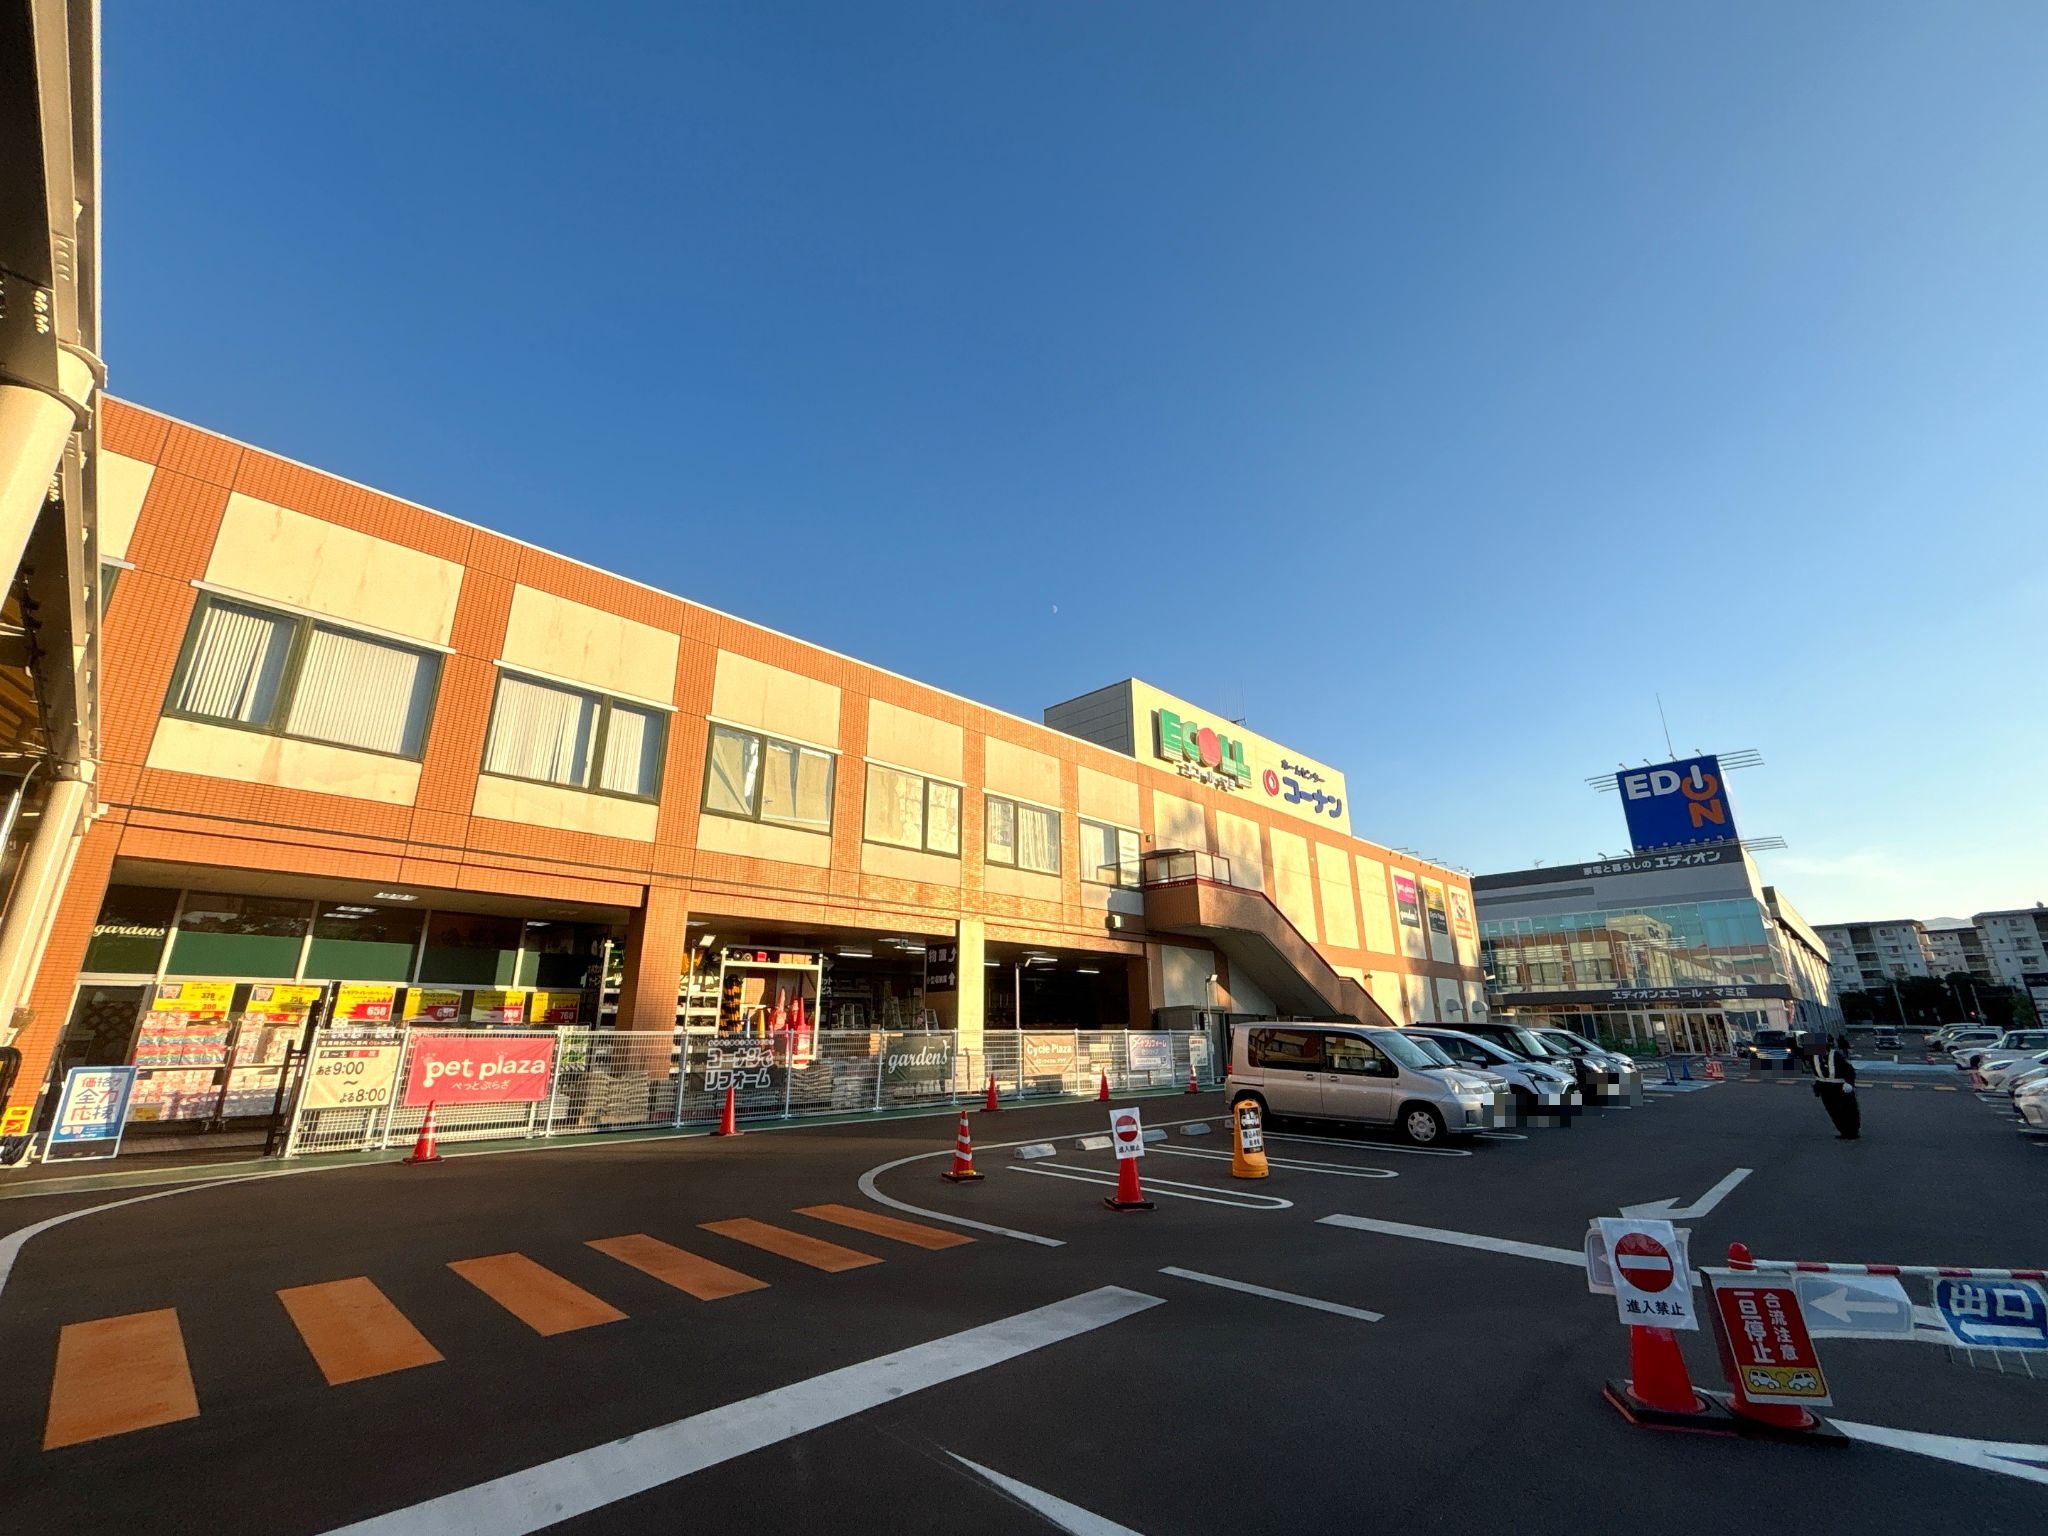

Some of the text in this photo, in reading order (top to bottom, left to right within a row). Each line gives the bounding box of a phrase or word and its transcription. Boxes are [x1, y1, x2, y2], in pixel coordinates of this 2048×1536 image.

[1159, 708, 1251, 788] ECOLL
[1281, 759, 1325, 783] ホームセンター
[1283, 776, 1342, 818] コーナン
[1583, 851, 1721, 876] 家電と暮らしの エディオン
[92, 924, 166, 938] gardens
[1612, 987, 1748, 1000] エディオンエコール・マミ店
[366, 1006, 387, 1016] 658
[706, 1047, 774, 1069] コーナンで
[888, 1039, 949, 1074] gardens
[1026, 1043, 1073, 1057] Cycle Plaza
[316, 1061, 365, 1075] あさ9:00
[423, 1053, 546, 1088] pet plaza
[704, 1067, 771, 1092] リフォーム
[75, 1088, 119, 1105] 全力
[339, 1088, 387, 1103] よる8:00
[451, 1079, 511, 1091] ぺっとぷらざ
[1626, 1298, 1686, 1317] 進入禁止
[1949, 1282, 2034, 1319] 出口
[1733, 1290, 1777, 1364] 一旦停止
[1763, 1292, 1799, 1361] 合流注意
